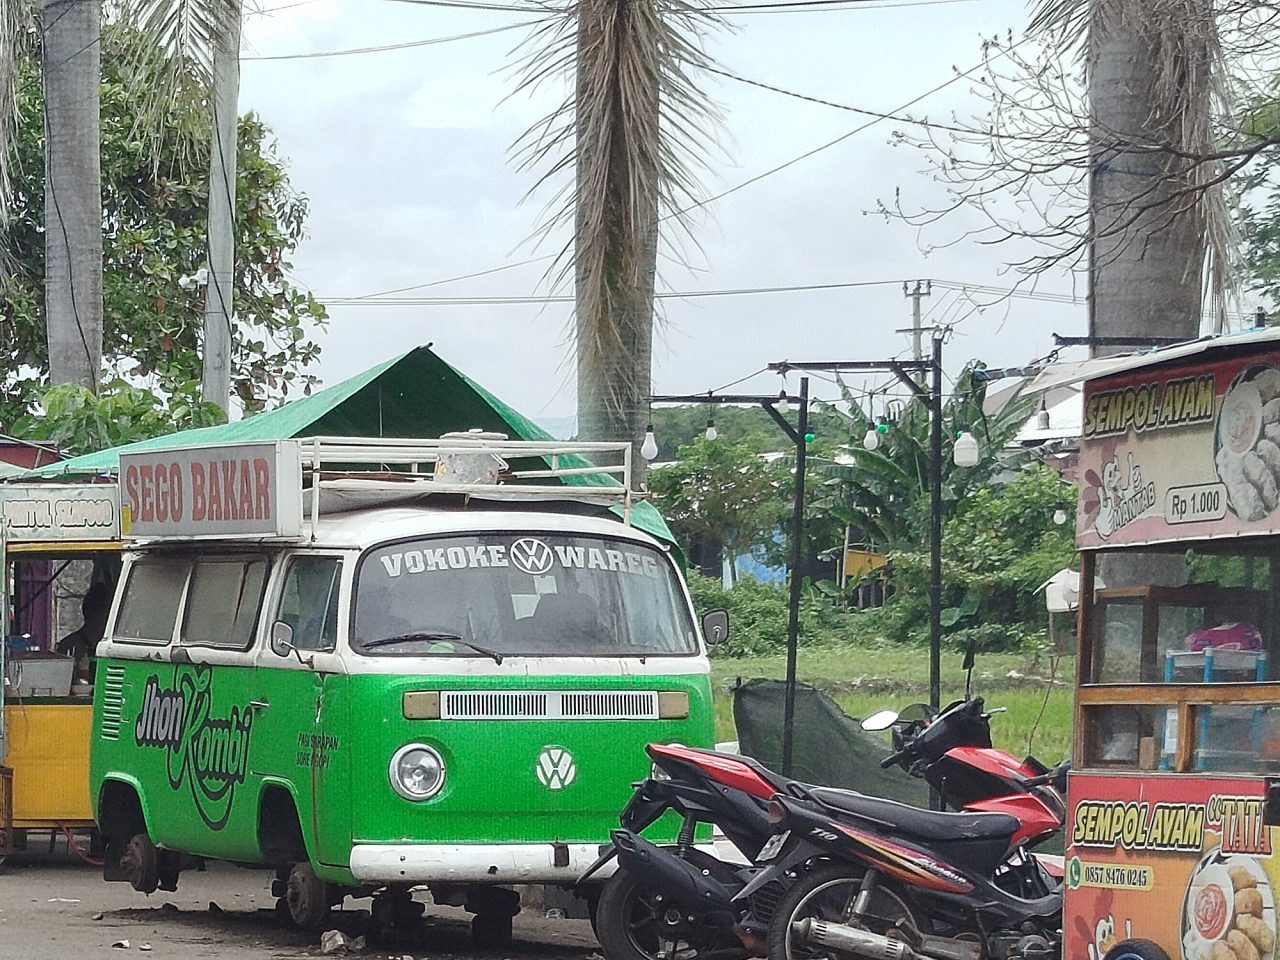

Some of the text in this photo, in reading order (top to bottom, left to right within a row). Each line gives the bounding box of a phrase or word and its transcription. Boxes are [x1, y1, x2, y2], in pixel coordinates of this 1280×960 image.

[1085, 378, 1213, 435] SEMPOL AYAM
[126, 458, 270, 523] SEGO BAKAR
[1114, 482, 1155, 532] MANTAB
[1172, 491, 1219, 519] Rp 1.000
[381, 545, 509, 577] VOKOKE
[554, 545, 658, 579] WAREG
[136, 681, 184, 744] Jhon
[1074, 802, 1146, 845] SEMPOL
[1151, 804, 1204, 849] AYAM
[1085, 866, 1147, 886] 0857 8476 0245
